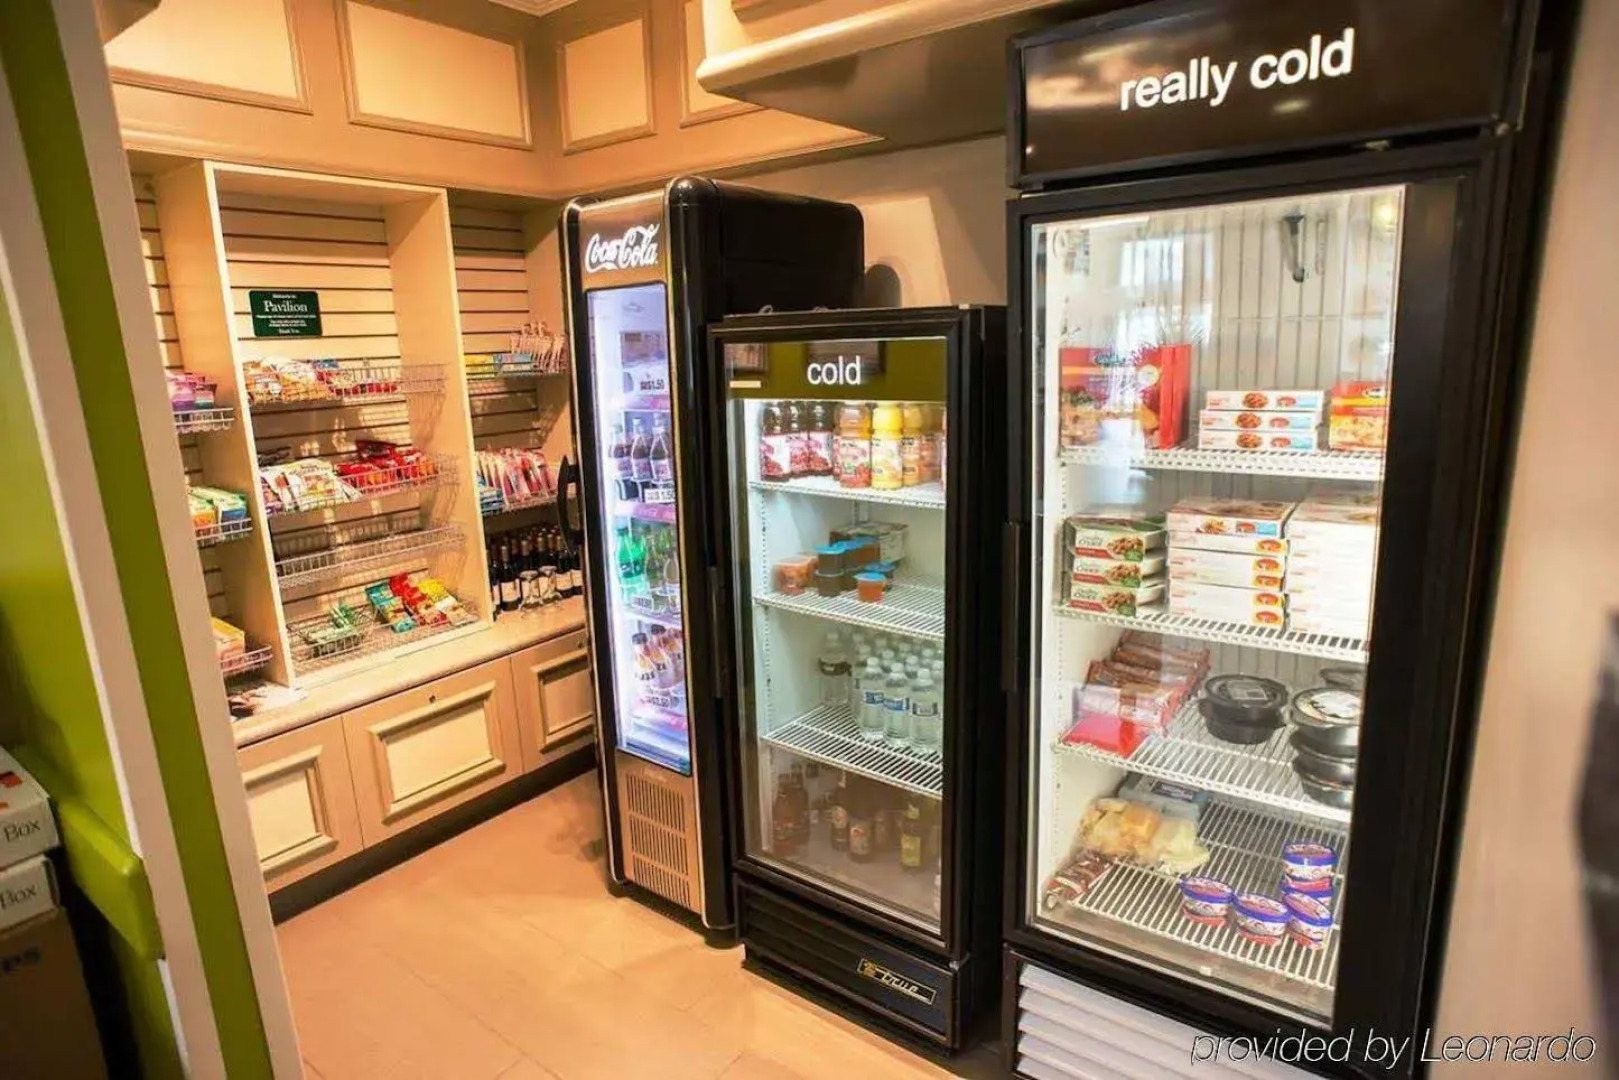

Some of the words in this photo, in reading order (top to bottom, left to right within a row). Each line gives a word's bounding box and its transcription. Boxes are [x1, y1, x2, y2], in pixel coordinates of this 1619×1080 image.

[1120, 56, 1239, 113] really
[1250, 27, 1355, 89] cold
[263, 300, 308, 312] Pavilion
[807, 355, 861, 385] cold
[4, 820, 41, 843] Box
[0, 884, 37, 910] Box
